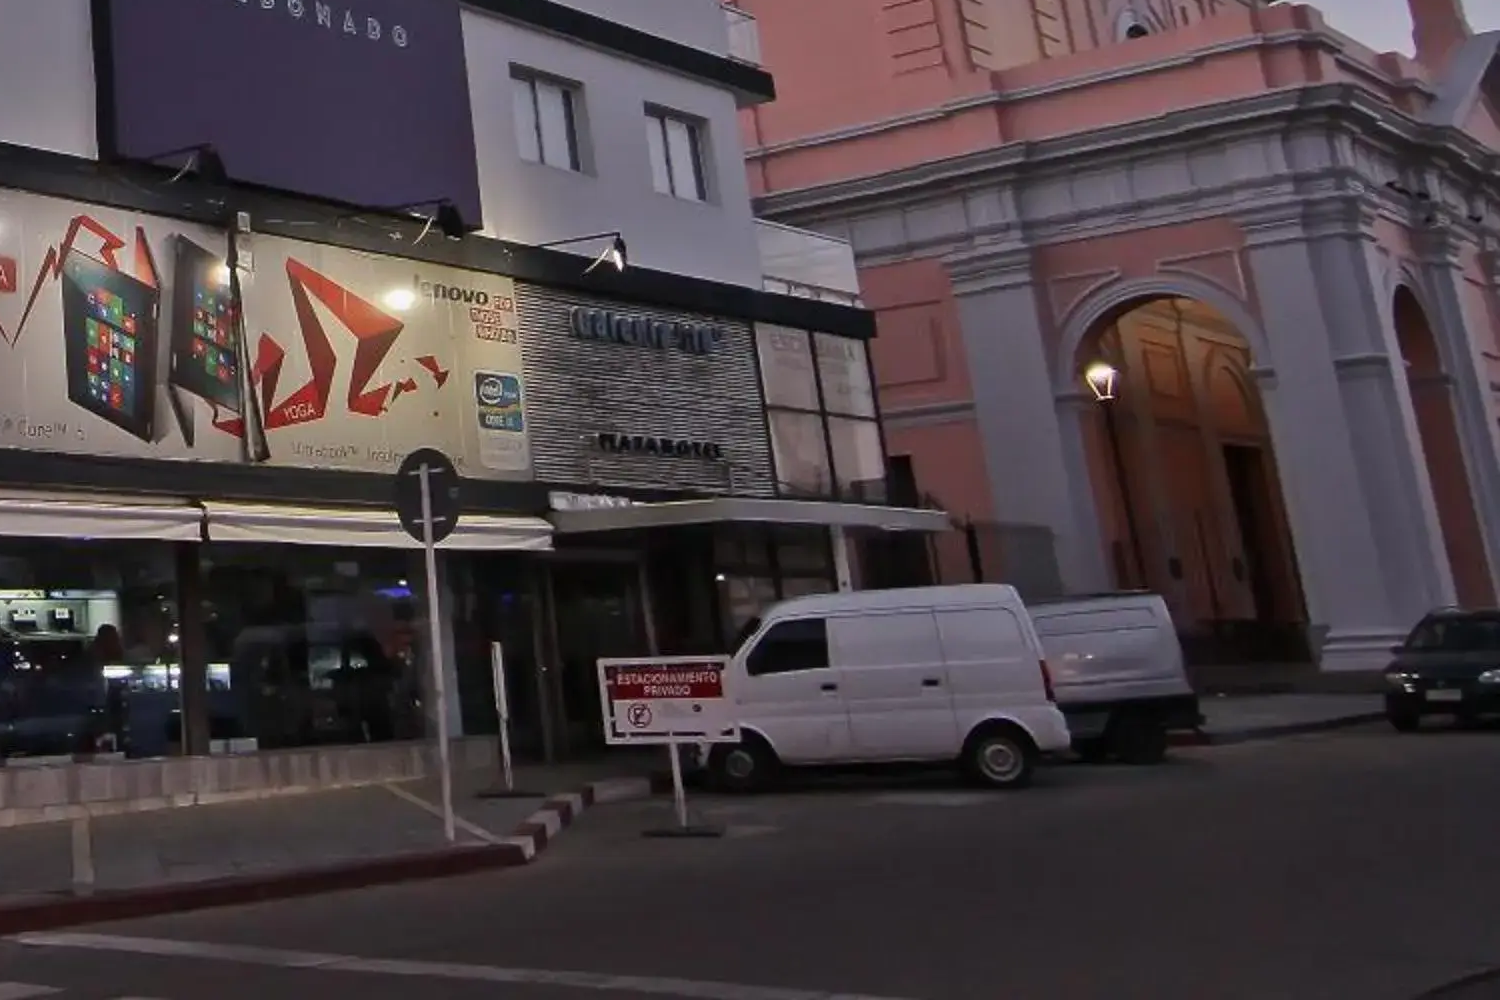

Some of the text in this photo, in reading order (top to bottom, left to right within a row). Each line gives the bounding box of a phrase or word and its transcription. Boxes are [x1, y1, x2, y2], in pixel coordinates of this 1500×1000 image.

[284, 403, 315, 420] YOGA
[616, 671, 717, 686] ESTACIONAMIENTO
[643, 685, 691, 697] PRIVADO
